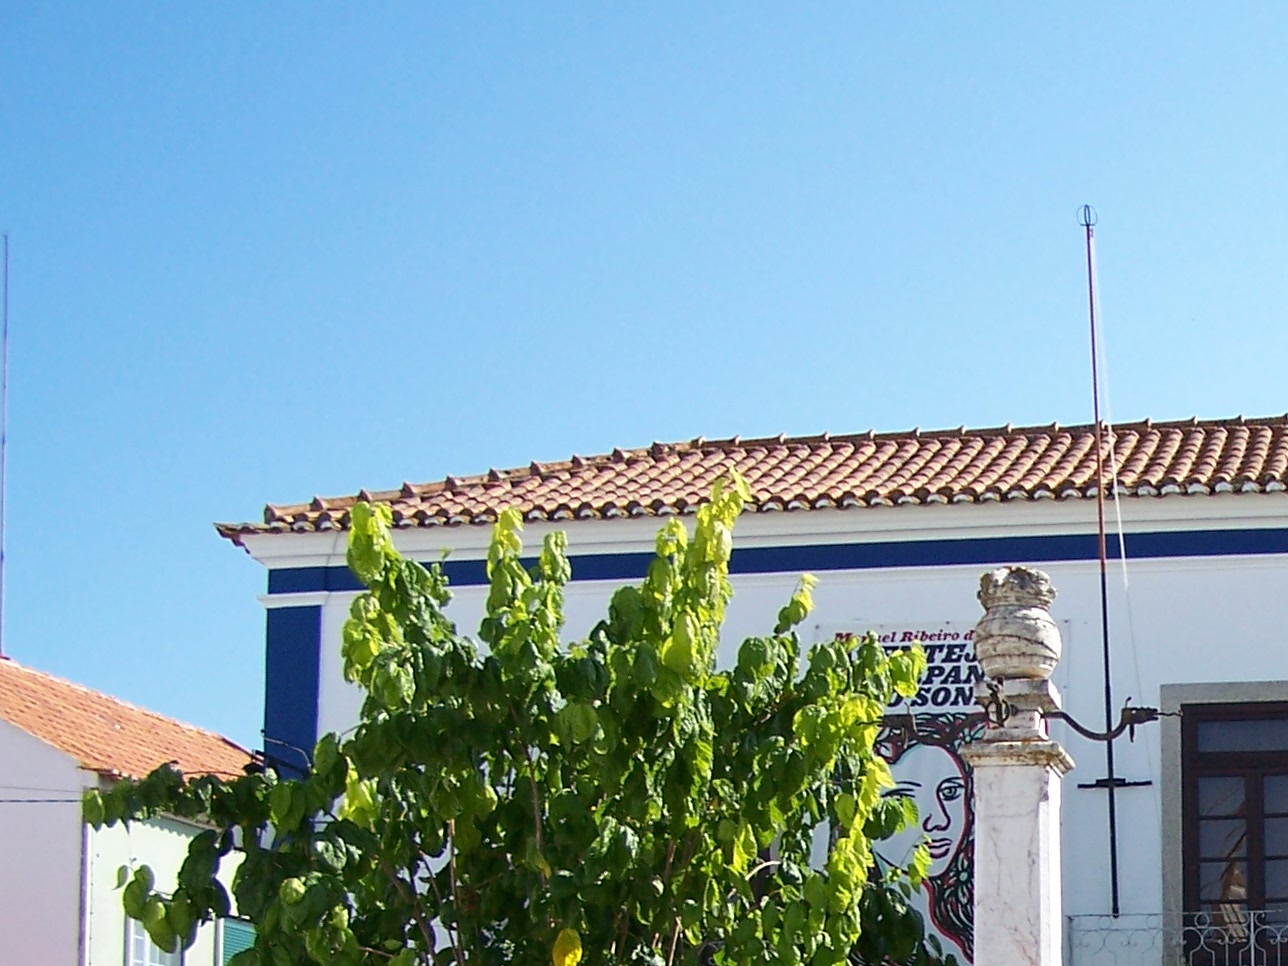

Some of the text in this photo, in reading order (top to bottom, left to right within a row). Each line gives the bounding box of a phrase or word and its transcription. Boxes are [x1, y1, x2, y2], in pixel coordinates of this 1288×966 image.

[900, 629, 960, 643] Ribeiro
[963, 629, 975, 641] d
[911, 686, 979, 708] SON
